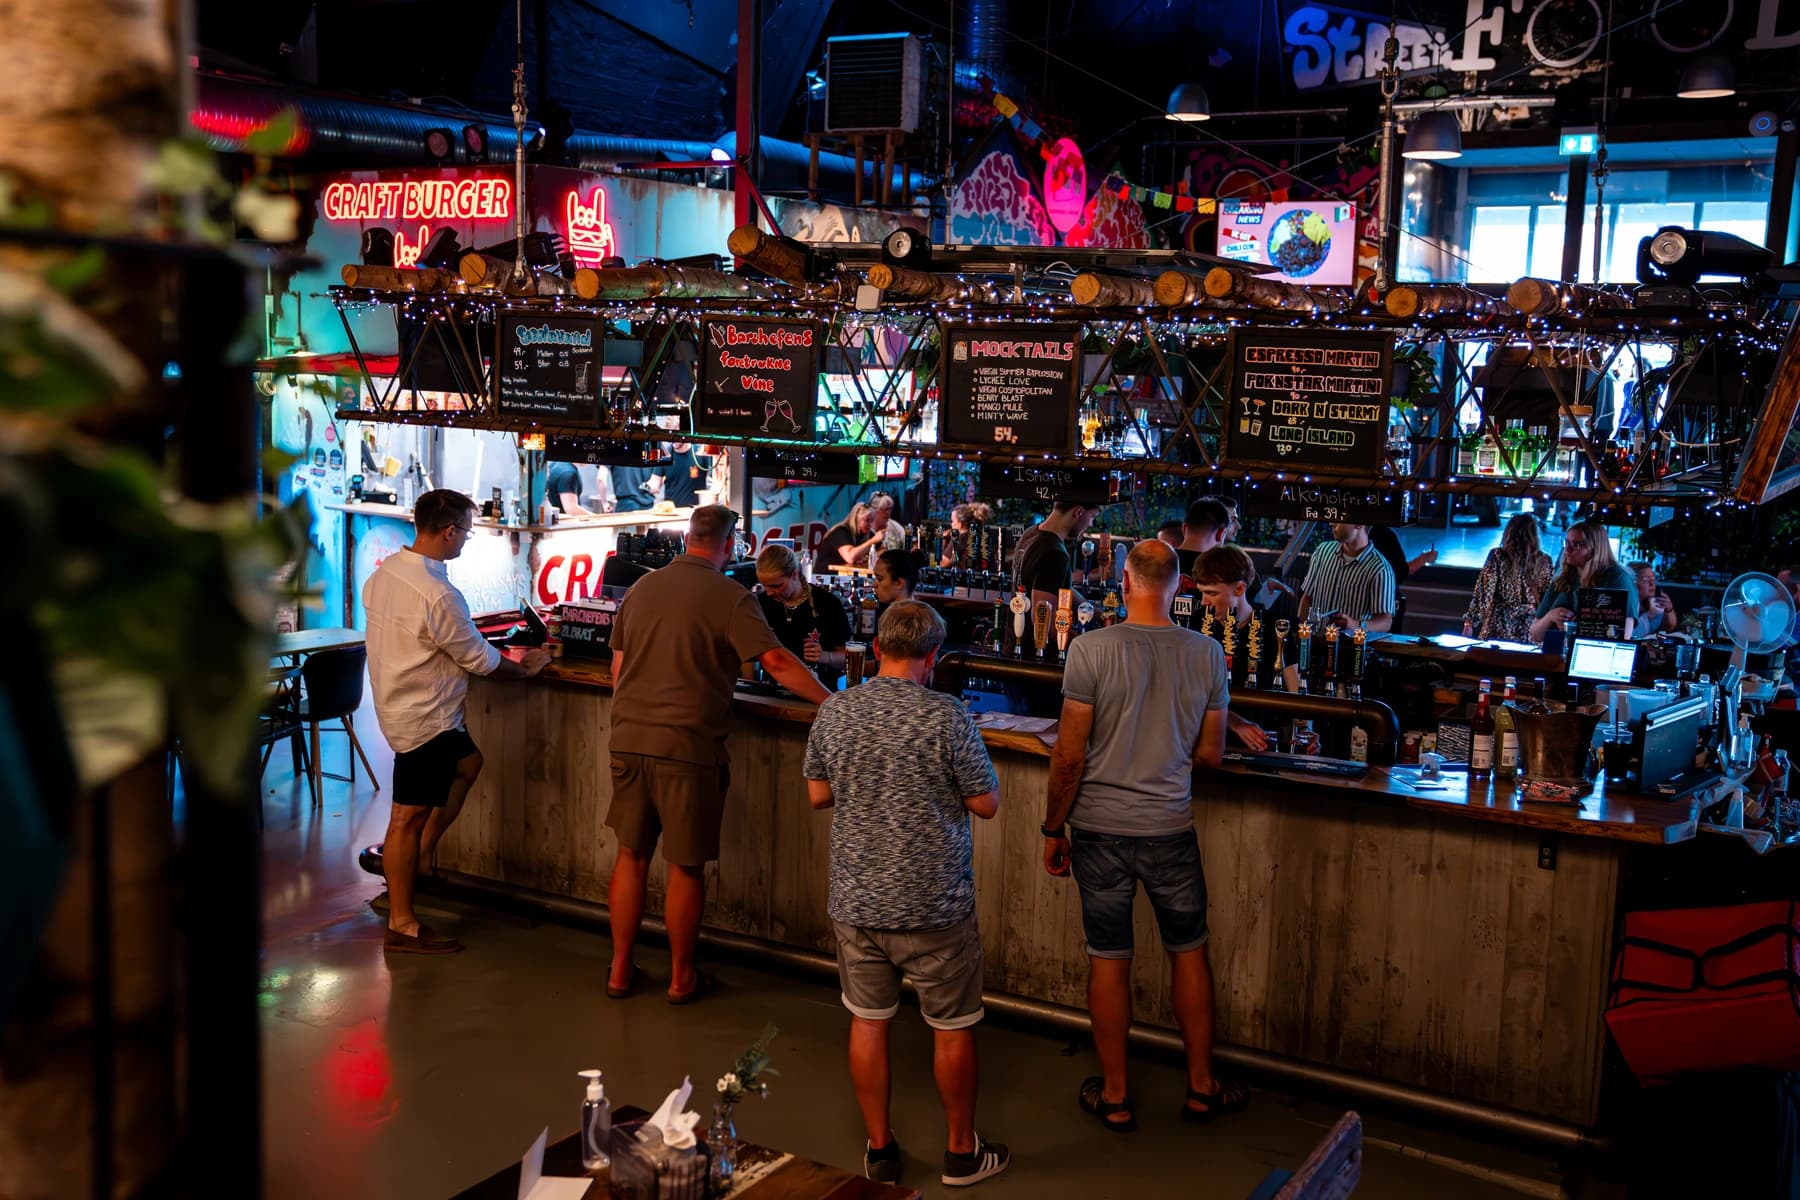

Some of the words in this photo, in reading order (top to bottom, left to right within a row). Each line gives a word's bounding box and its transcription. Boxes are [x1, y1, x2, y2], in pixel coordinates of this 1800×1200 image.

[324, 182, 402, 220] CRAFT
[403, 179, 510, 219] BURGER
[1237, 215, 1261, 224] NEWS
[971, 340, 1074, 361] MOCKTAILS
[1245, 346, 1324, 365] ESPRESSO
[1325, 350, 1380, 368] MARTINI
[979, 367, 998, 376] VIRGIN
[1000, 367, 1025, 376] SUMMER
[1026, 368, 1063, 379] EXPLOSION
[979, 376, 1005, 385] LYCHEE
[1008, 377, 1031, 386] LOVE
[1245, 372, 1325, 392] PORNSTAR
[1325, 375, 1382, 395] MARTINI
[978, 386, 997, 394] VIRGIN
[998, 387, 1053, 395] COSMOPOLITAN
[977, 394, 999, 402] BERRY
[1001, 394, 1025, 402] BLAST
[977, 403, 1001, 411] MANGO
[1003, 403, 1024, 411] MULE
[1272, 400, 1310, 417] DARK
[1329, 403, 1380, 422] STORMY
[977, 412, 1004, 420] MINTY
[1006, 412, 1029, 420] WAVE
[1269, 425, 1304, 443] LONG
[1306, 426, 1355, 446] ISLAND
[1176, 600, 1191, 613] IPA
